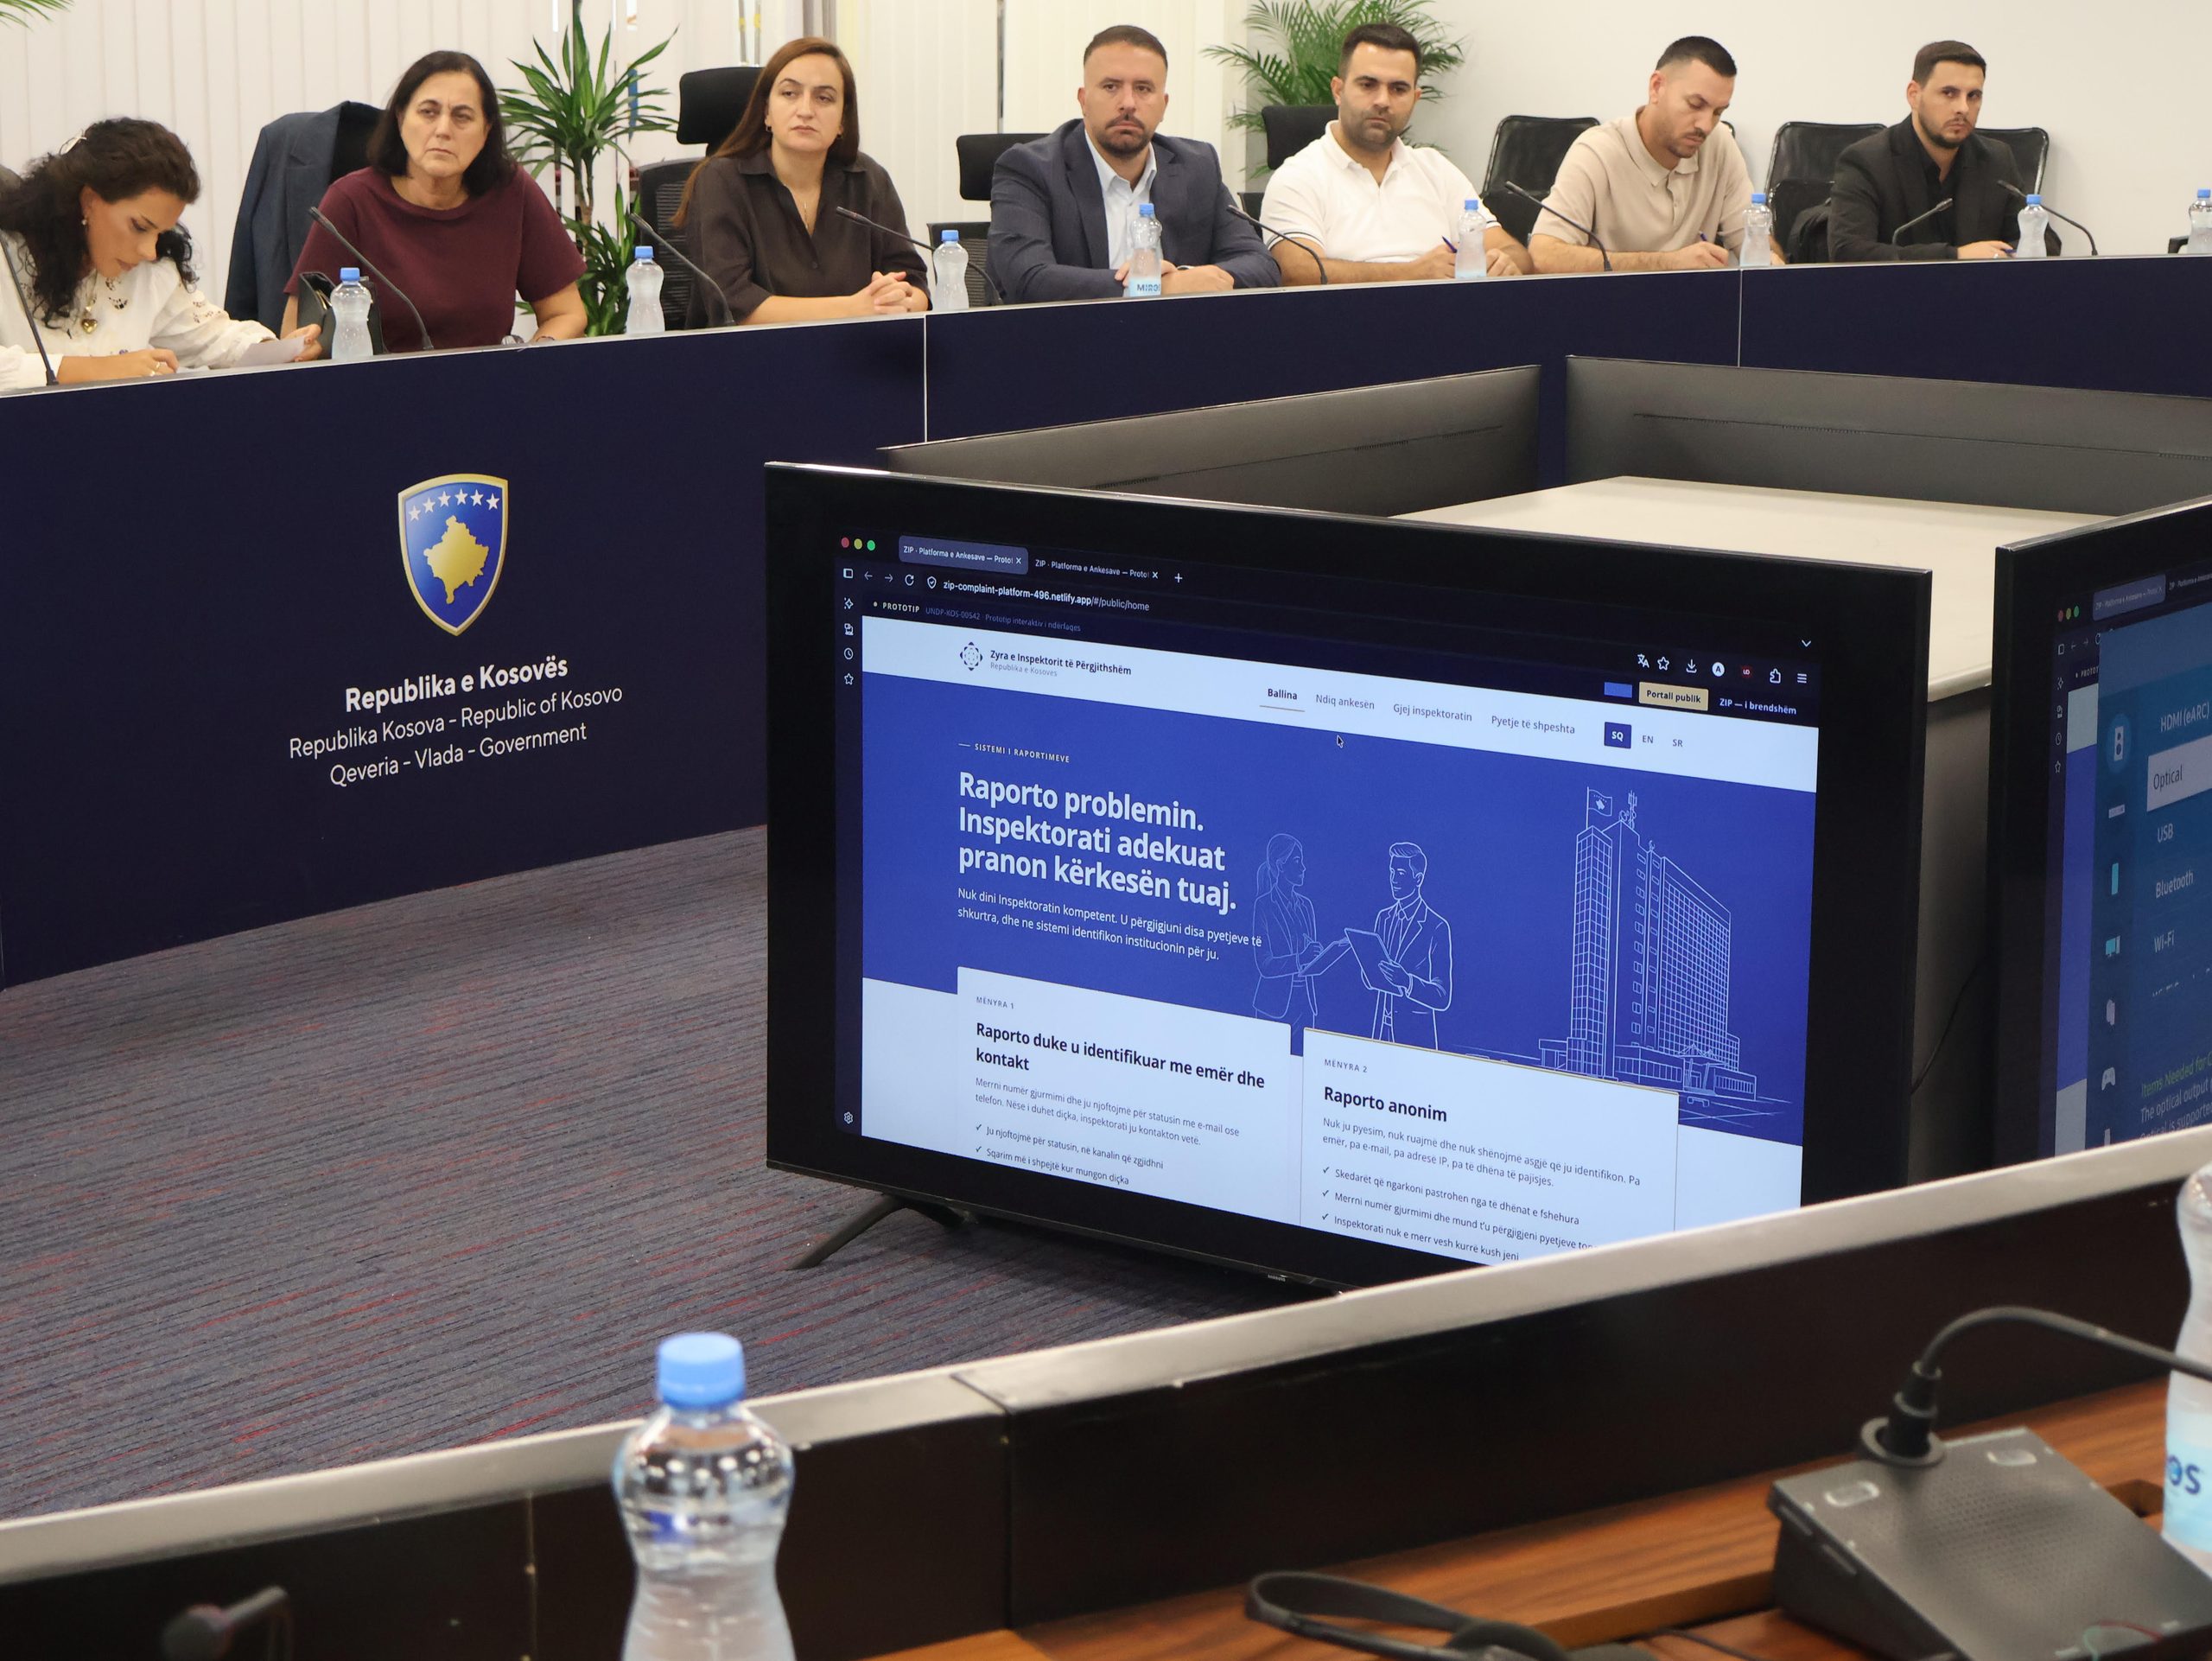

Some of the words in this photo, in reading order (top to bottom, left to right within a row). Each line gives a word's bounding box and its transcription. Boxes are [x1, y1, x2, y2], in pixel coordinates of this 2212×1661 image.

[919, 548, 948, 557] Platforma
[956, 551, 985, 561] Ankesave
[1052, 561, 1082, 571] Platforma
[1090, 565, 1120, 575] Ankesave
[883, 602, 919, 612] PROTOTIP
[991, 651, 1008, 661] Zyra
[1018, 653, 1063, 666] Inspektorit
[1077, 660, 1131, 674] Përgjithshëm
[346, 675, 455, 712] Republika
[461, 675, 474, 691] e
[480, 656, 568, 689] Kosovës
[1268, 689, 1297, 699] Ballina
[1316, 695, 1336, 707] Ndiq
[1647, 690, 1673, 699] Portali
[1675, 694, 1700, 703] publik
[290, 727, 377, 758] Republika
[383, 718, 444, 741] Kosova
[462, 700, 536, 727] Republic
[540, 696, 556, 713] of
[562, 689, 622, 710] Kosovo
[1394, 704, 1409, 716] Gjej
[1413, 706, 1471, 721] inspektoratin
[1492, 716, 1519, 729] Pyetje
[1522, 720, 1530, 729] të
[1534, 721, 1574, 734] shpeshta
[2160, 710, 2183, 733] HDMI
[2183, 702, 2209, 728] (eARC)
[976, 743, 1005, 754] SISTEMI
[1014, 749, 1069, 762] RAPORTIMEVE
[1612, 731, 1623, 741] SQ
[331, 756, 398, 786] Qeveria
[415, 744, 463, 768] Vlada
[480, 722, 587, 757] Government
[2153, 765, 2183, 791] Optical
[961, 772, 1058, 809] Raporto
[1065, 792, 1203, 830] problemin.
[960, 807, 1110, 853] Inspektorati
[1118, 833, 1224, 870] adekuat
[2157, 824, 2174, 843] USB
[960, 848, 1046, 879] pranon
[1055, 856, 1170, 899] kërkesën
[1178, 878, 1236, 914] tuaj.
[2156, 869, 2194, 899] Bluetooth
[958, 888, 976, 901] Nuk
[979, 892, 995, 903] dini
[999, 894, 1060, 913] Inspektoratin
[1064, 905, 1117, 923] kompetent.
[1121, 914, 1128, 925] U
[1131, 917, 1181, 934] përgjigjuni
[1185, 925, 1204, 937] disa
[1208, 931, 1249, 945] pyetjeve
[1252, 936, 1262, 946] të
[958, 907, 999, 924] shkurtra,
[1002, 914, 1019, 926] dhe
[1037, 920, 1069, 934] sistemi
[1072, 926, 1122, 944] identifikon
[1126, 935, 1185, 954] institucionin
[1188, 946, 1205, 958] për
[1206, 948, 1218, 961] ju.
[2154, 930, 2175, 953] Wi-Fi
[977, 1023, 1029, 1044] Raporto
[1033, 1034, 1067, 1051] duke
[1071, 1043, 1079, 1053] u
[1084, 1042, 1166, 1069] identifikuar
[1171, 1061, 1192, 1074] me
[1196, 1066, 1234, 1082] emër
[1237, 1071, 1264, 1088] dhe
[977, 1047, 1029, 1070] kontakt
[2196, 1055, 2207, 1073] for
[976, 1078, 1001, 1089] Merrni
[1030, 1090, 1065, 1102] gjurmimi
[1067, 1096, 1082, 1105] dhe
[1149, 1113, 1180, 1124] statusin
[1198, 1123, 1223, 1133] e-mail
[1225, 1128, 1239, 1136] ose
[976, 1094, 1003, 1106] telefon.
[1032, 1104, 1053, 1117] duhet
[1057, 1111, 1077, 1122] diçka,
[1081, 1114, 1127, 1130] inspektorati
[1128, 1124, 1136, 1134] ju
[1139, 1125, 1179, 1141] kontakton
[1325, 1087, 1384, 1110] Raporto
[1389, 1102, 1446, 1122] anonim
[2140, 1106, 2155, 1123] The
[2156, 1089, 2182, 1116] optical
[2183, 1078, 2208, 1101] output
[987, 1127, 994, 1136] Ju
[1048, 1141, 1078, 1153] statusin,
[1093, 1148, 1120, 1160] kanalin
[1134, 1158, 1163, 1168] zgjidhni
[1324, 1117, 1340, 1129] Nuk
[1342, 1123, 1350, 1132] ju
[1353, 1125, 1385, 1138] pyesim,
[1389, 1132, 1404, 1141] nuk
[1440, 1140, 1456, 1150] dhe
[1459, 1145, 1475, 1154] nuk
[1563, 1163, 1572, 1174] ju
[1575, 1165, 1625, 1182] identifikon.
[1630, 1175, 1640, 1186] Pa
[1363, 1143, 1391, 1155] e-mail,
[1440, 1156, 1449, 1167] IP,
[1452, 1161, 1463, 1169] pa
[1519, 1174, 1553, 1186] pajisjes.
[987, 1149, 1012, 1161] Sqarim
[1062, 1163, 1073, 1172] kur
[1076, 1168, 1107, 1181] mungon
[1109, 1174, 1128, 1185] diçka
[1335, 1193, 1362, 1205] Merrni
[1395, 1206, 1431, 1219] gjurmimi
[1434, 1212, 1450, 1223] dhe
[1452, 1218, 1477, 1228] mund
[1540, 1236, 1576, 1248] pyetjeve
[1387, 1181, 1422, 1193] ngarkoni
[1426, 1189, 1468, 1202] pastrohen
[1471, 1198, 1486, 1207] nga
[1541, 1210, 1579, 1225] fshehura
[1335, 1217, 1383, 1233] Inspektorati
[1386, 1228, 1401, 1237] nuk
[1411, 1233, 1431, 1243] merr
[1433, 1238, 1452, 1247] vesh
[1481, 1246, 1501, 1257] kush
[1503, 1251, 1518, 1261] jeni
